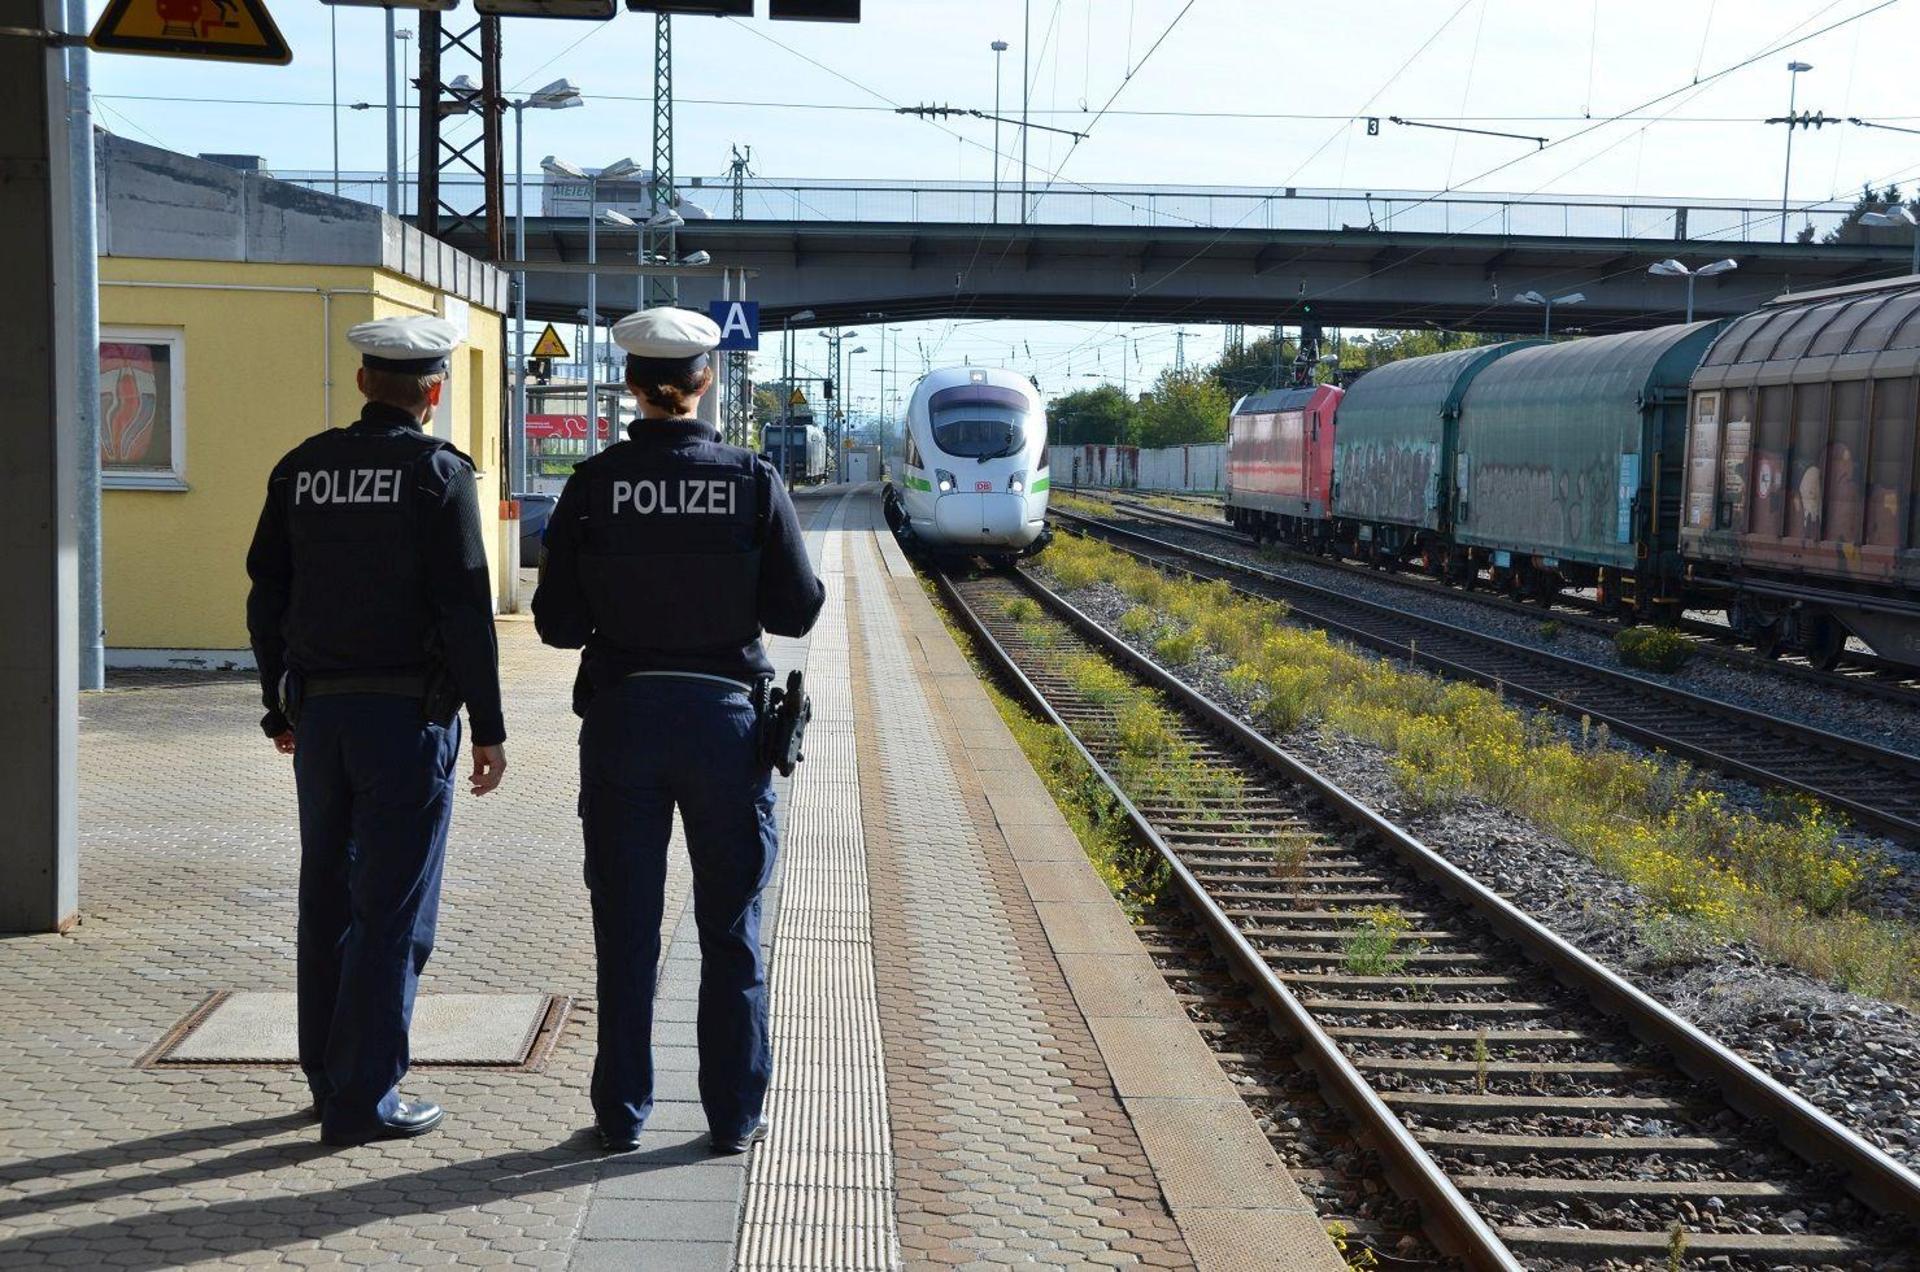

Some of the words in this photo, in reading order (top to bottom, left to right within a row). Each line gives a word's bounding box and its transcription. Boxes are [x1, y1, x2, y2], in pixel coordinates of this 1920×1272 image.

[1369, 120, 1377, 134] 3
[721, 302, 751, 339] A
[295, 469, 402, 505] POLIZEI
[612, 480, 736, 515] POLIZEI
[976, 482, 992, 491] DB
